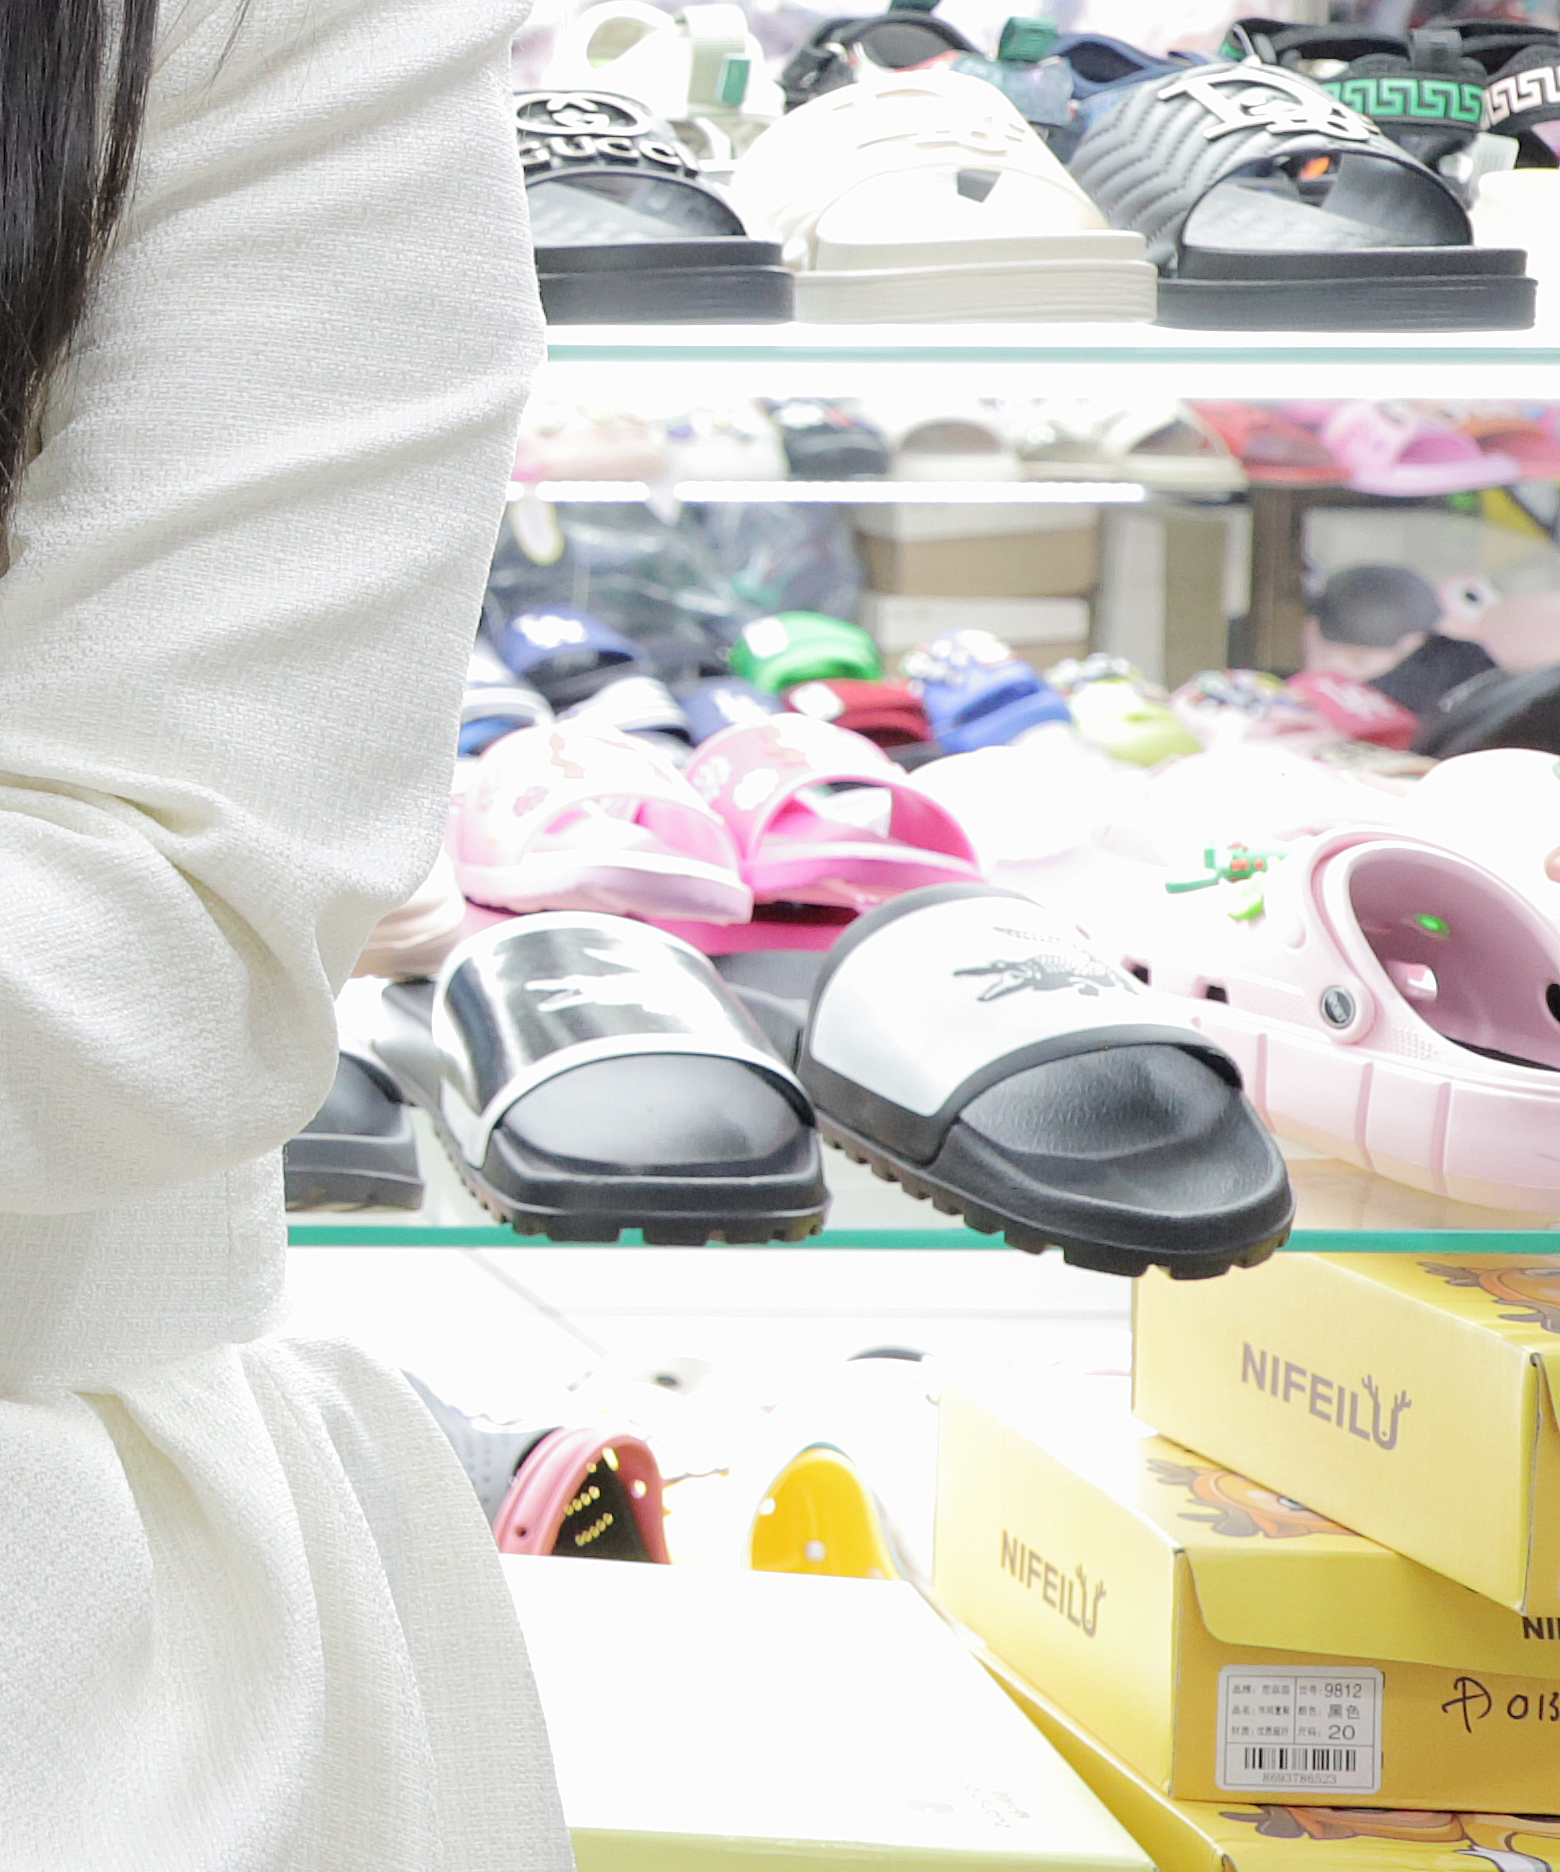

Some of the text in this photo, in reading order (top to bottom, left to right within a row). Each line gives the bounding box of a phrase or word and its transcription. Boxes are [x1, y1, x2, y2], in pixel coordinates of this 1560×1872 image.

[1522, 1616, 1560, 1639] NI
[1324, 1682, 1363, 1699] 9812
[1328, 1724, 1357, 1741] 20
